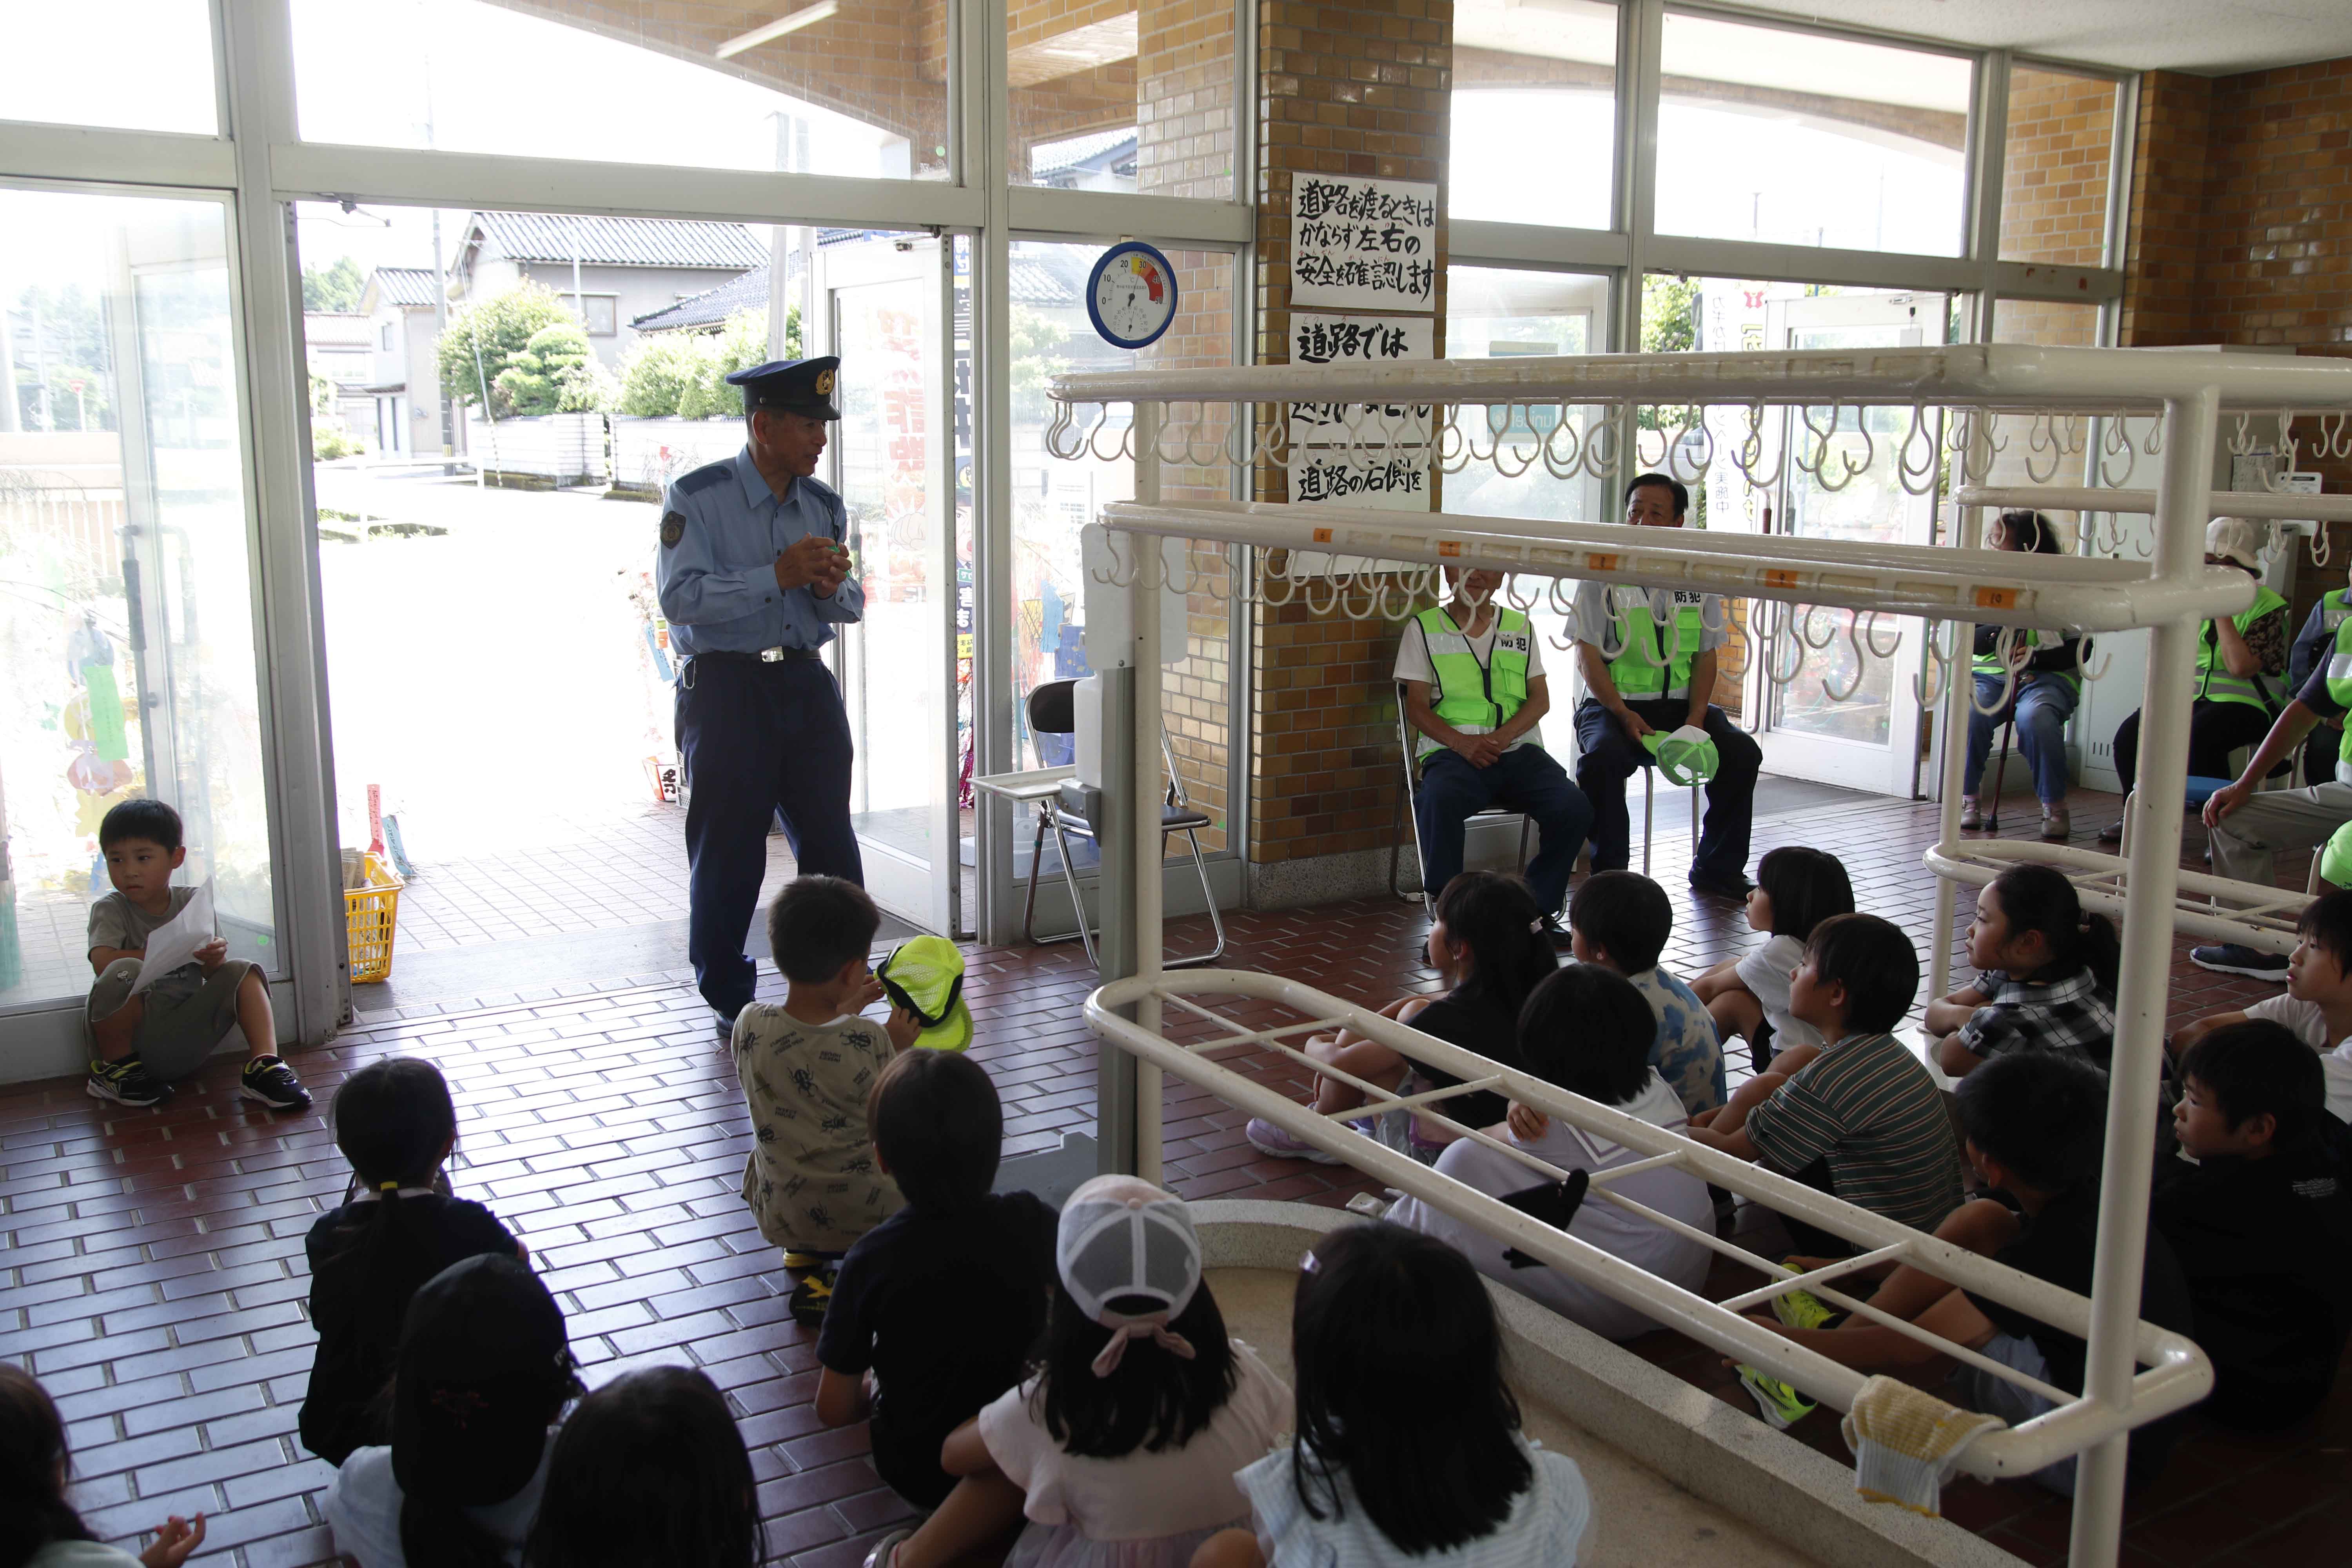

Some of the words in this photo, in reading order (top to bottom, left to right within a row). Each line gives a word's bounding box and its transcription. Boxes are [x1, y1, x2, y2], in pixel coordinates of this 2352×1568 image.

[1296, 179, 1434, 227] 道路を渡るときは
[1299, 221, 1421, 255] かならず左右の
[1296, 253, 1434, 303] 安全を確認します
[1297, 323, 1408, 363] 道路では
[1297, 458, 1422, 501] 道路の右側を
[1674, 591, 1700, 603] 防犯
[1991, 592, 2002, 604] 10
